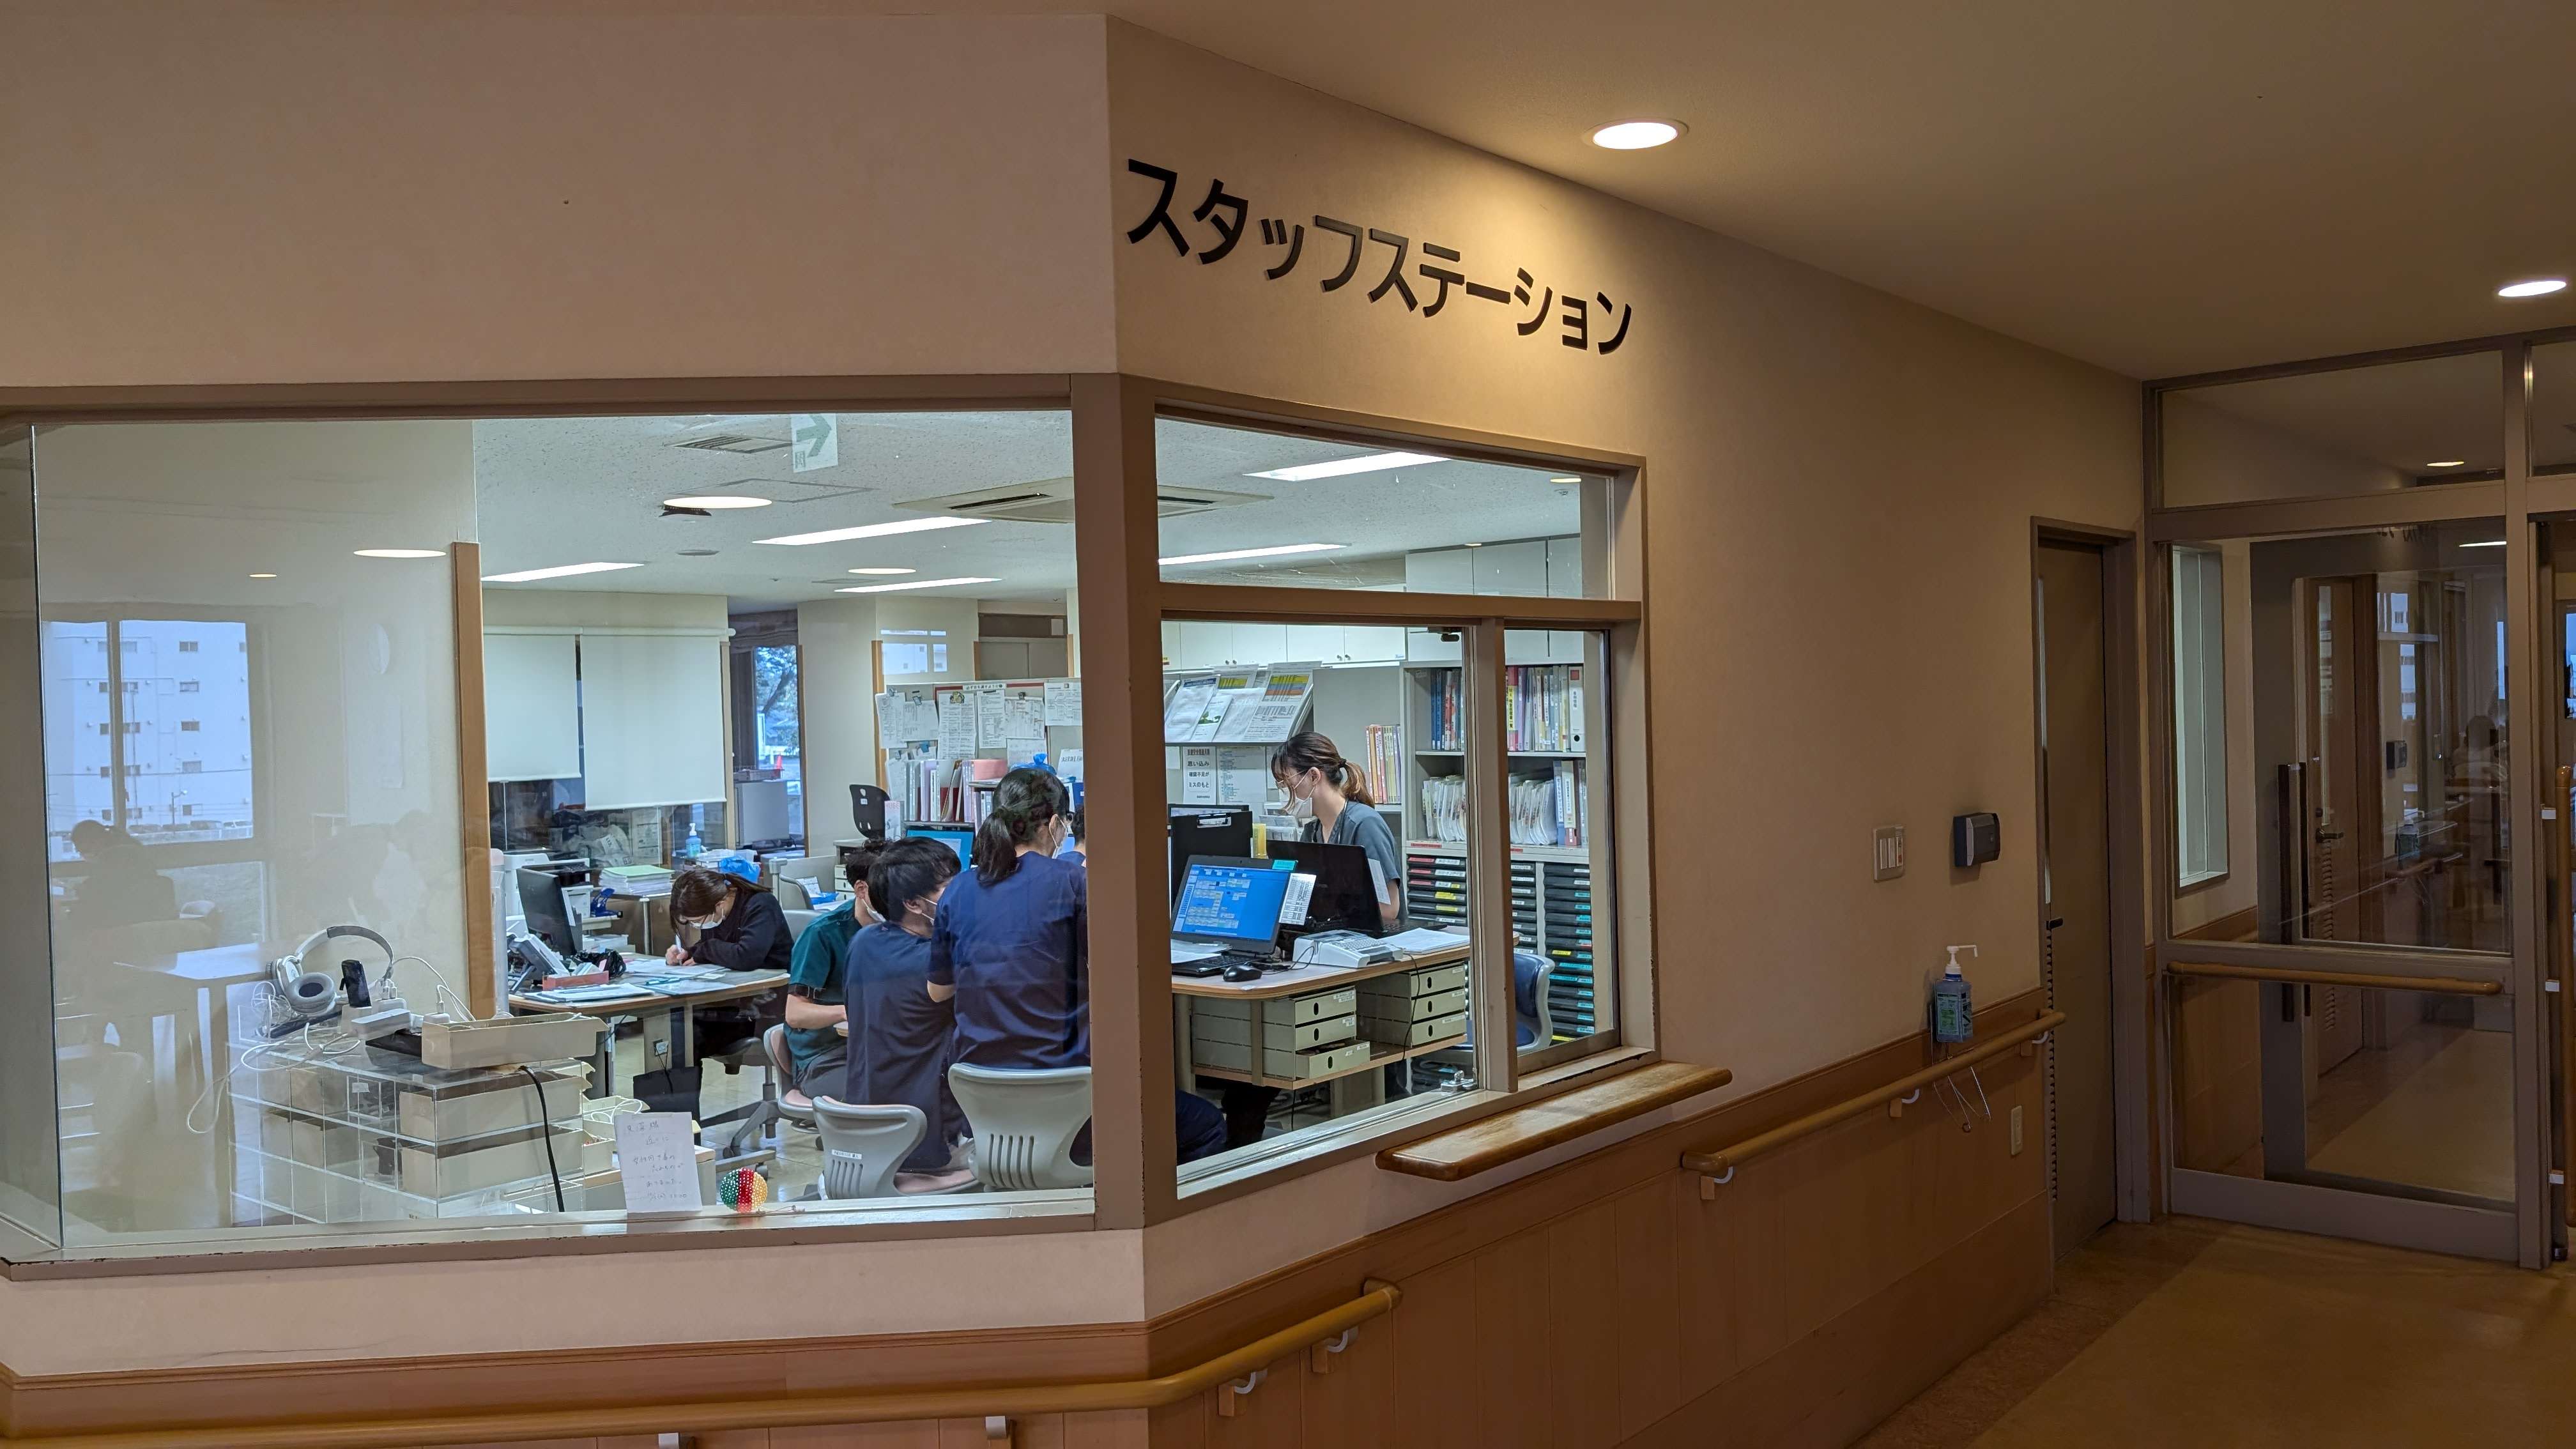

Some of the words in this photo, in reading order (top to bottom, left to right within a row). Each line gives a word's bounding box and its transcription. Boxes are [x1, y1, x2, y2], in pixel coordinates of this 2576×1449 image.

[1127, 158, 1632, 355] スタッフステーション
